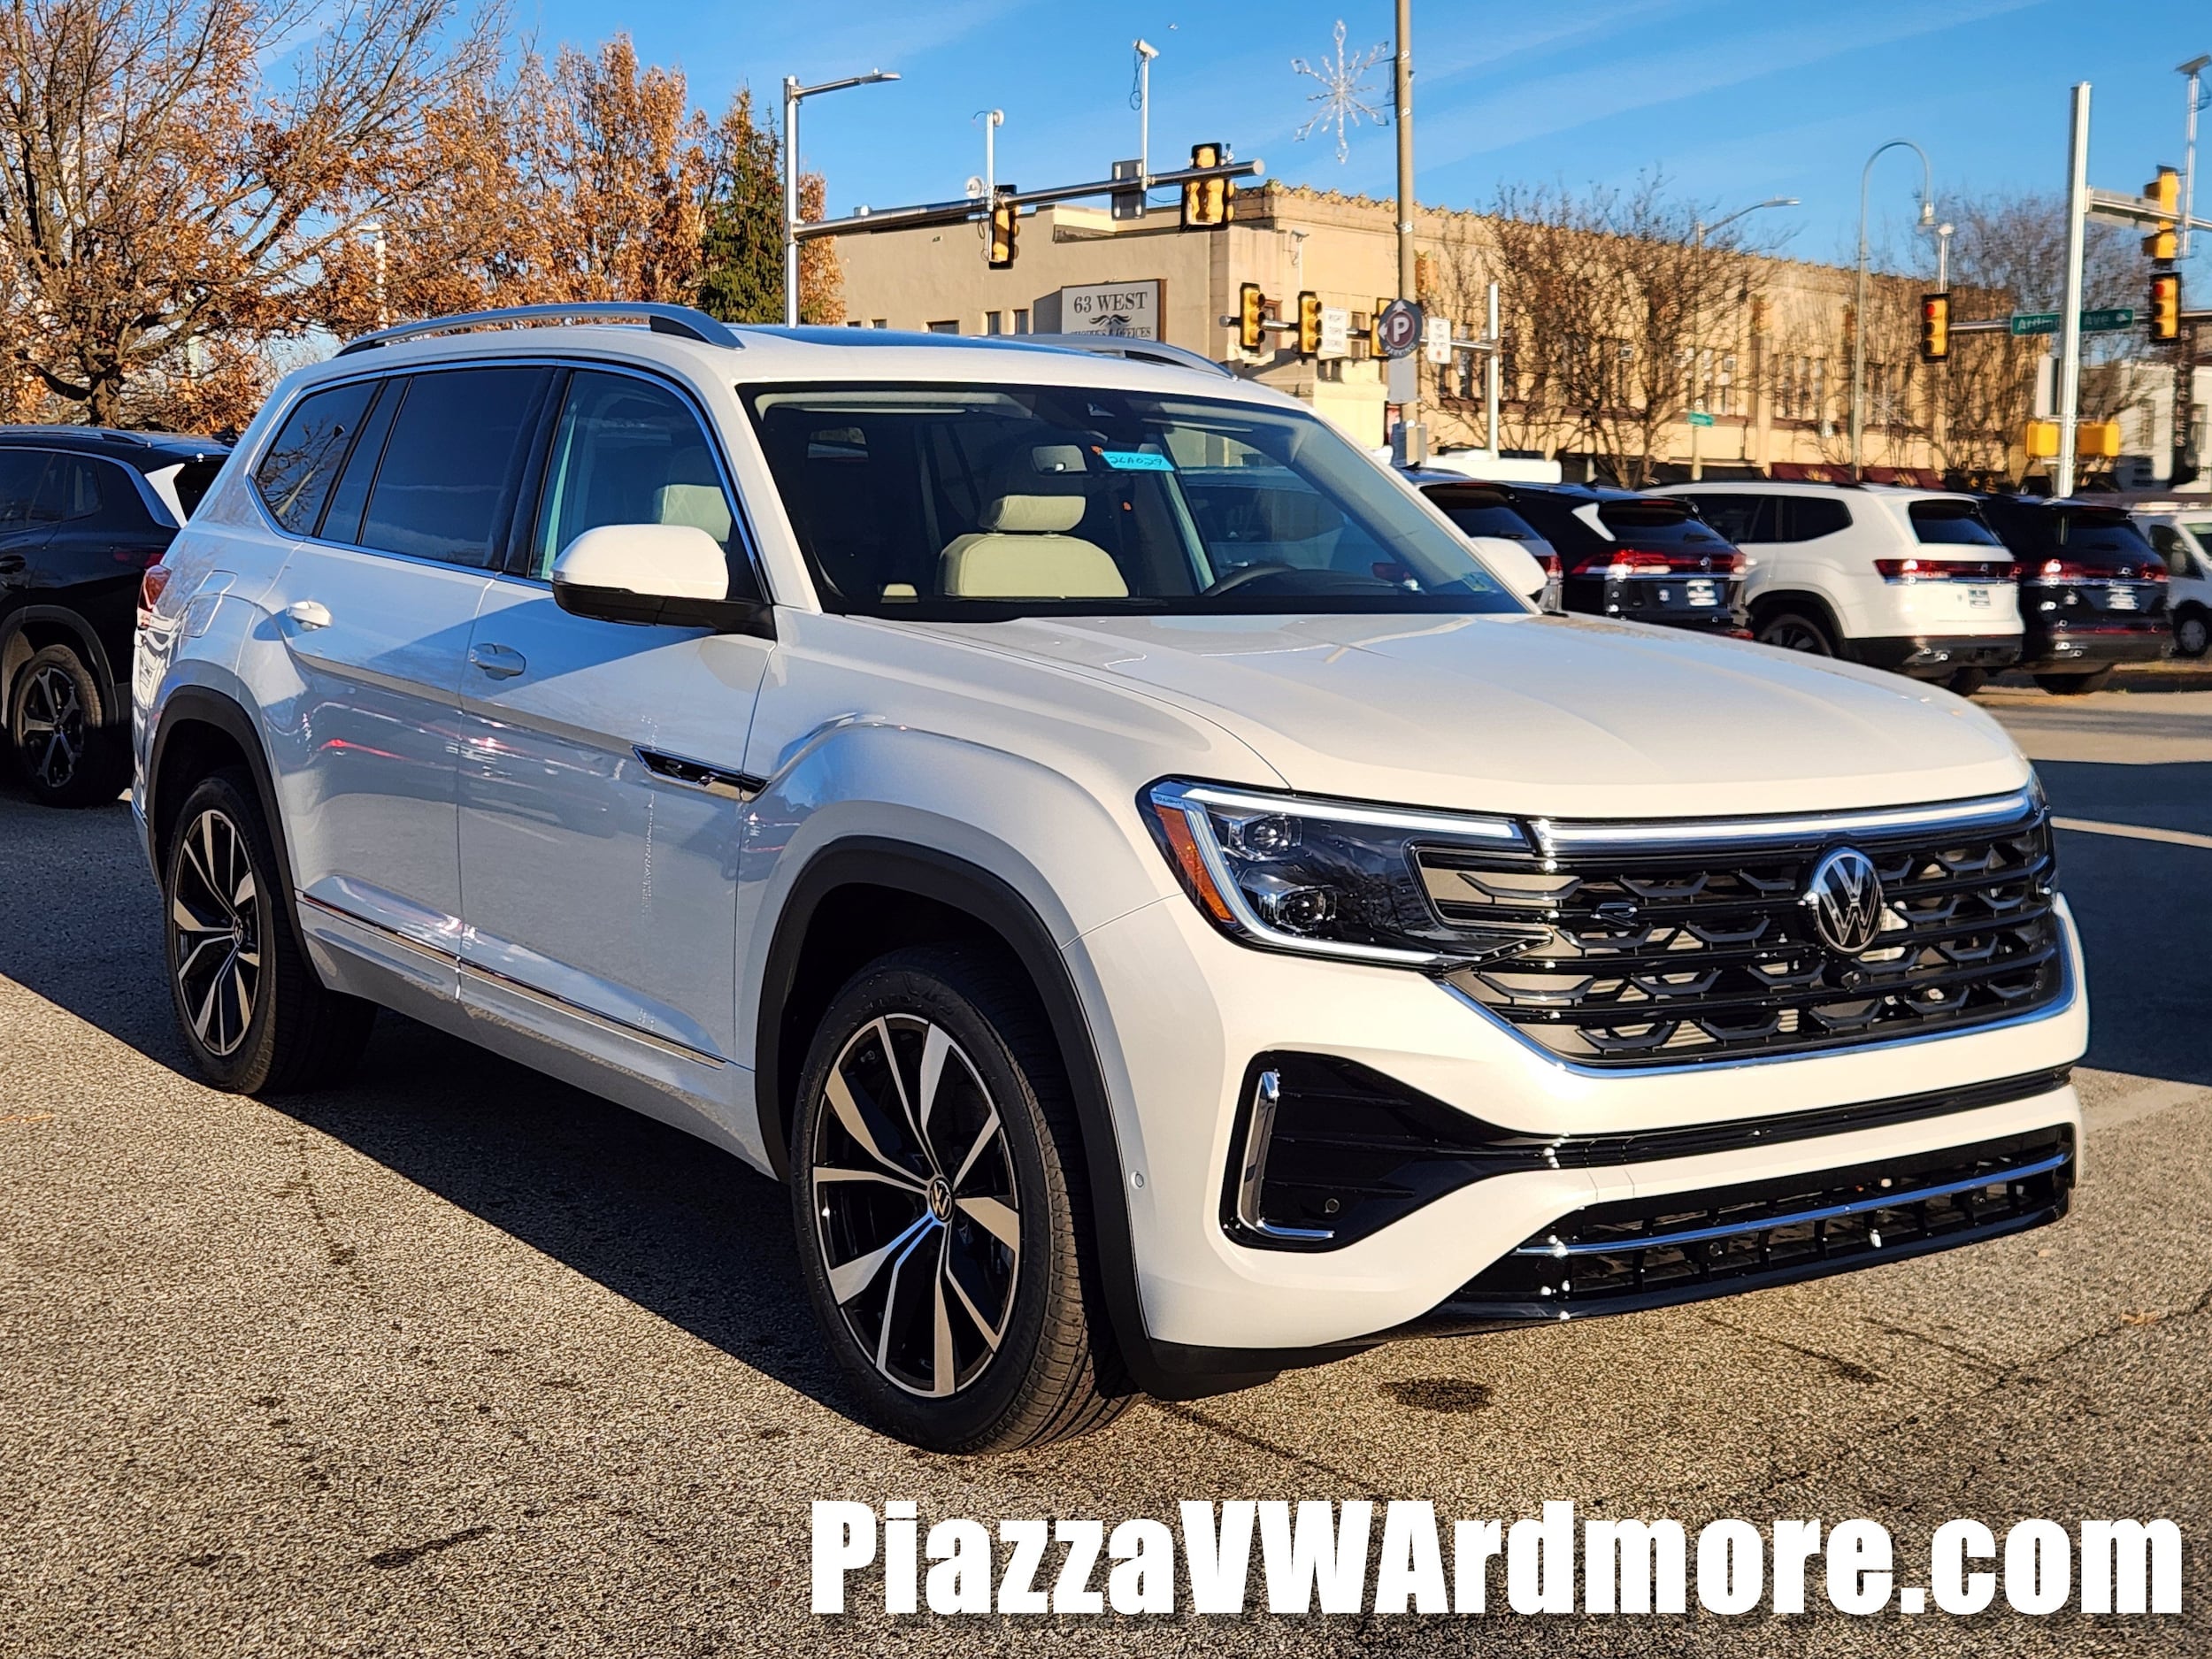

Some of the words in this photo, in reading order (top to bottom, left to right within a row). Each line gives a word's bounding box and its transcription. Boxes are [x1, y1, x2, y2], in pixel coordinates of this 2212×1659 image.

[1074, 296, 1092, 313] 63
[1096, 292, 1148, 311] WEST
[2083, 314, 2109, 326] Ave
[1393, 317, 1410, 342] P
[1385, 342, 1417, 356] PARKING
